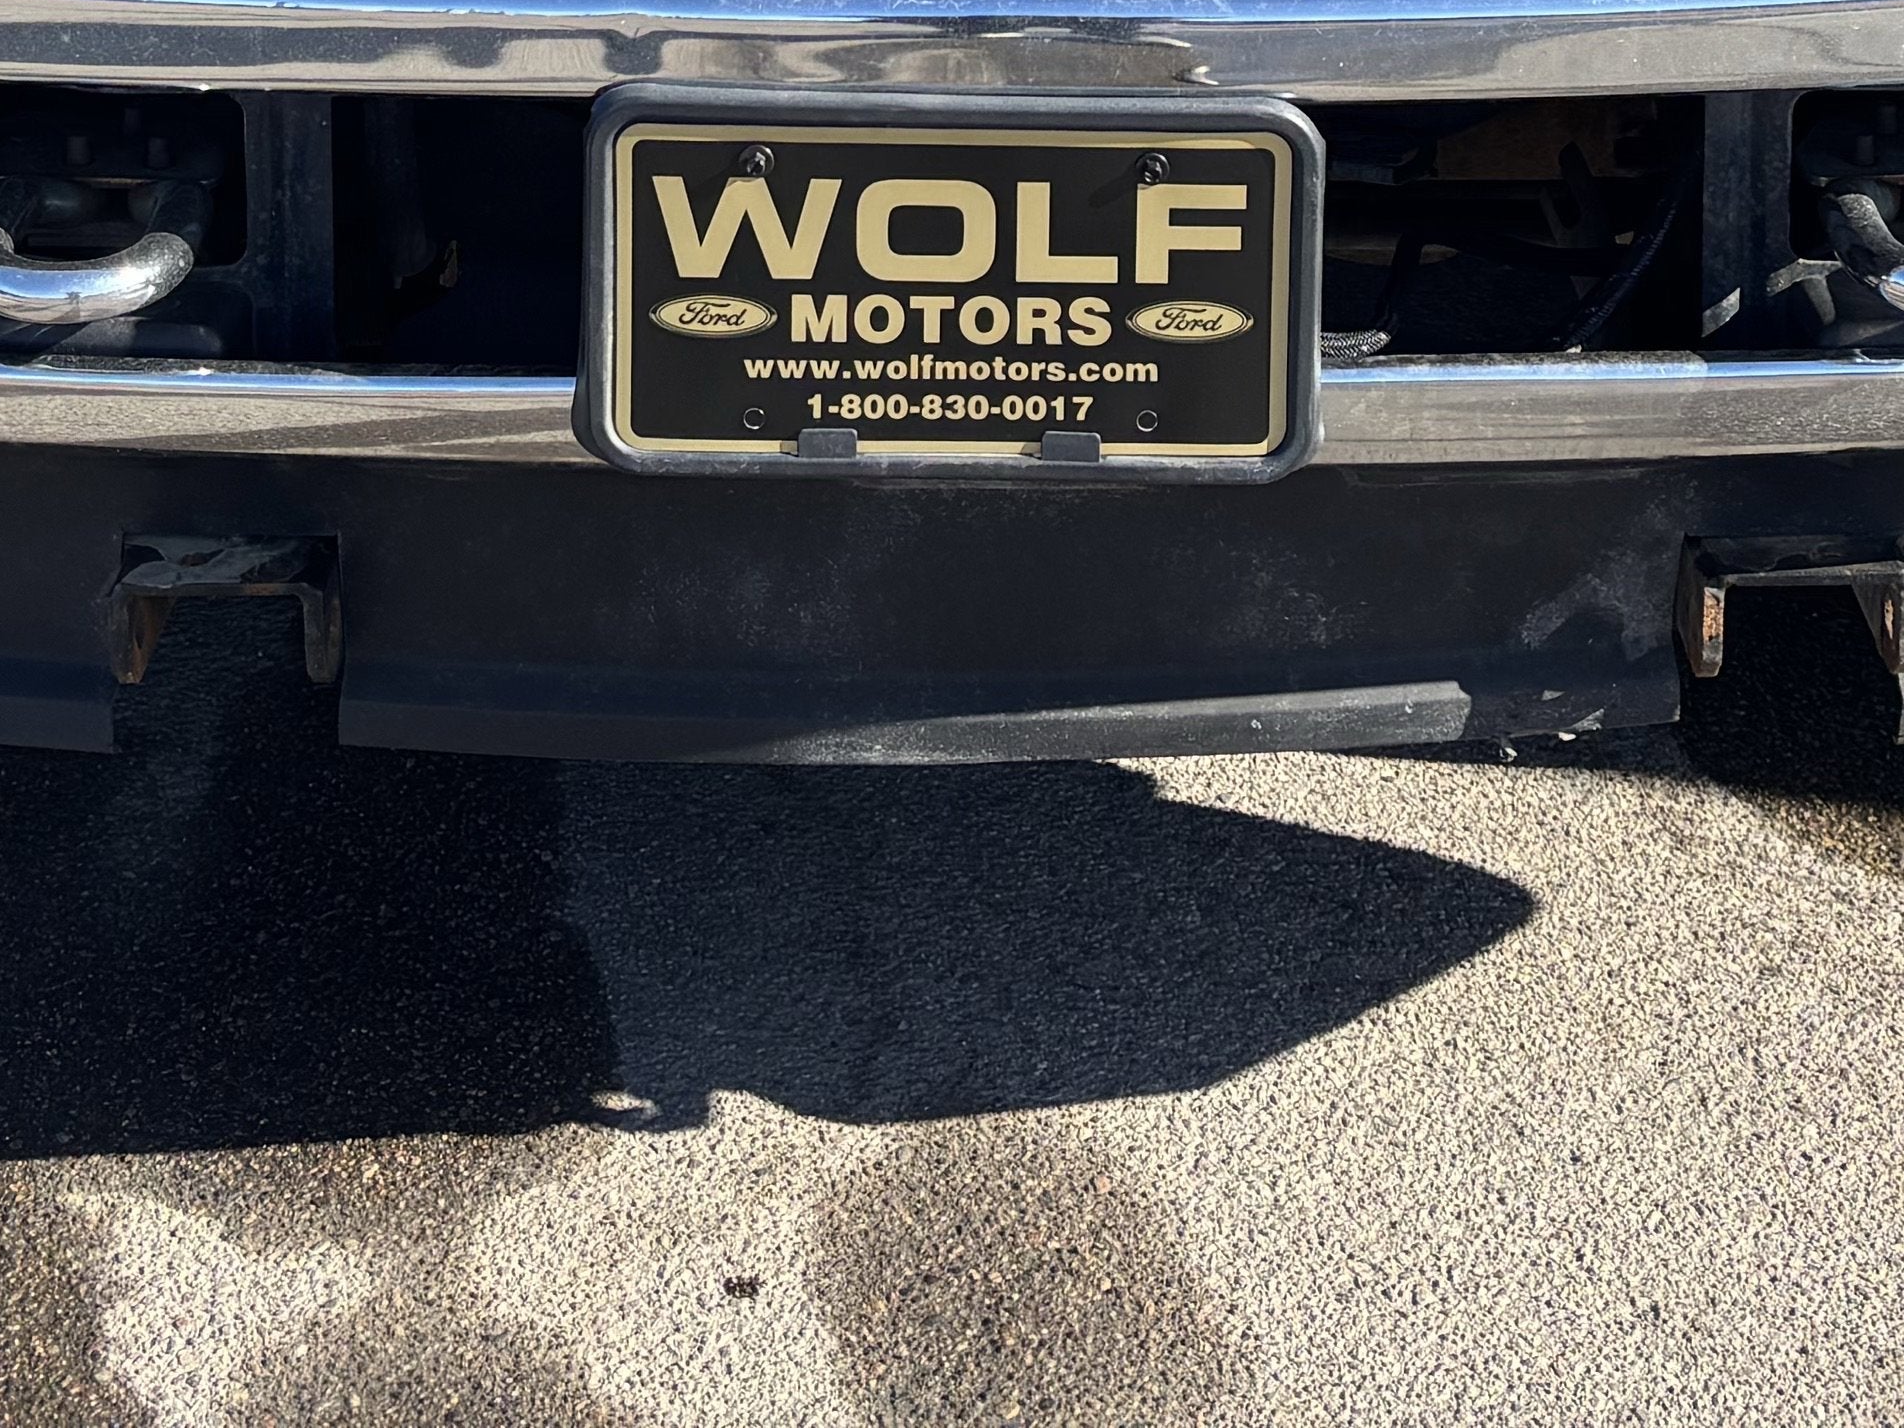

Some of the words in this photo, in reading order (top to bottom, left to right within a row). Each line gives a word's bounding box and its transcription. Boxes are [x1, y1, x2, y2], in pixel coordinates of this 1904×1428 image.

[651, 175, 1248, 284] WOLF
[679, 301, 747, 326] Ford
[791, 294, 1113, 346] MOTORS
[1155, 307, 1223, 331] Ford
[743, 354, 1159, 382] www.wolfmotors.com
[807, 393, 1094, 421] 1-800-830-0017
